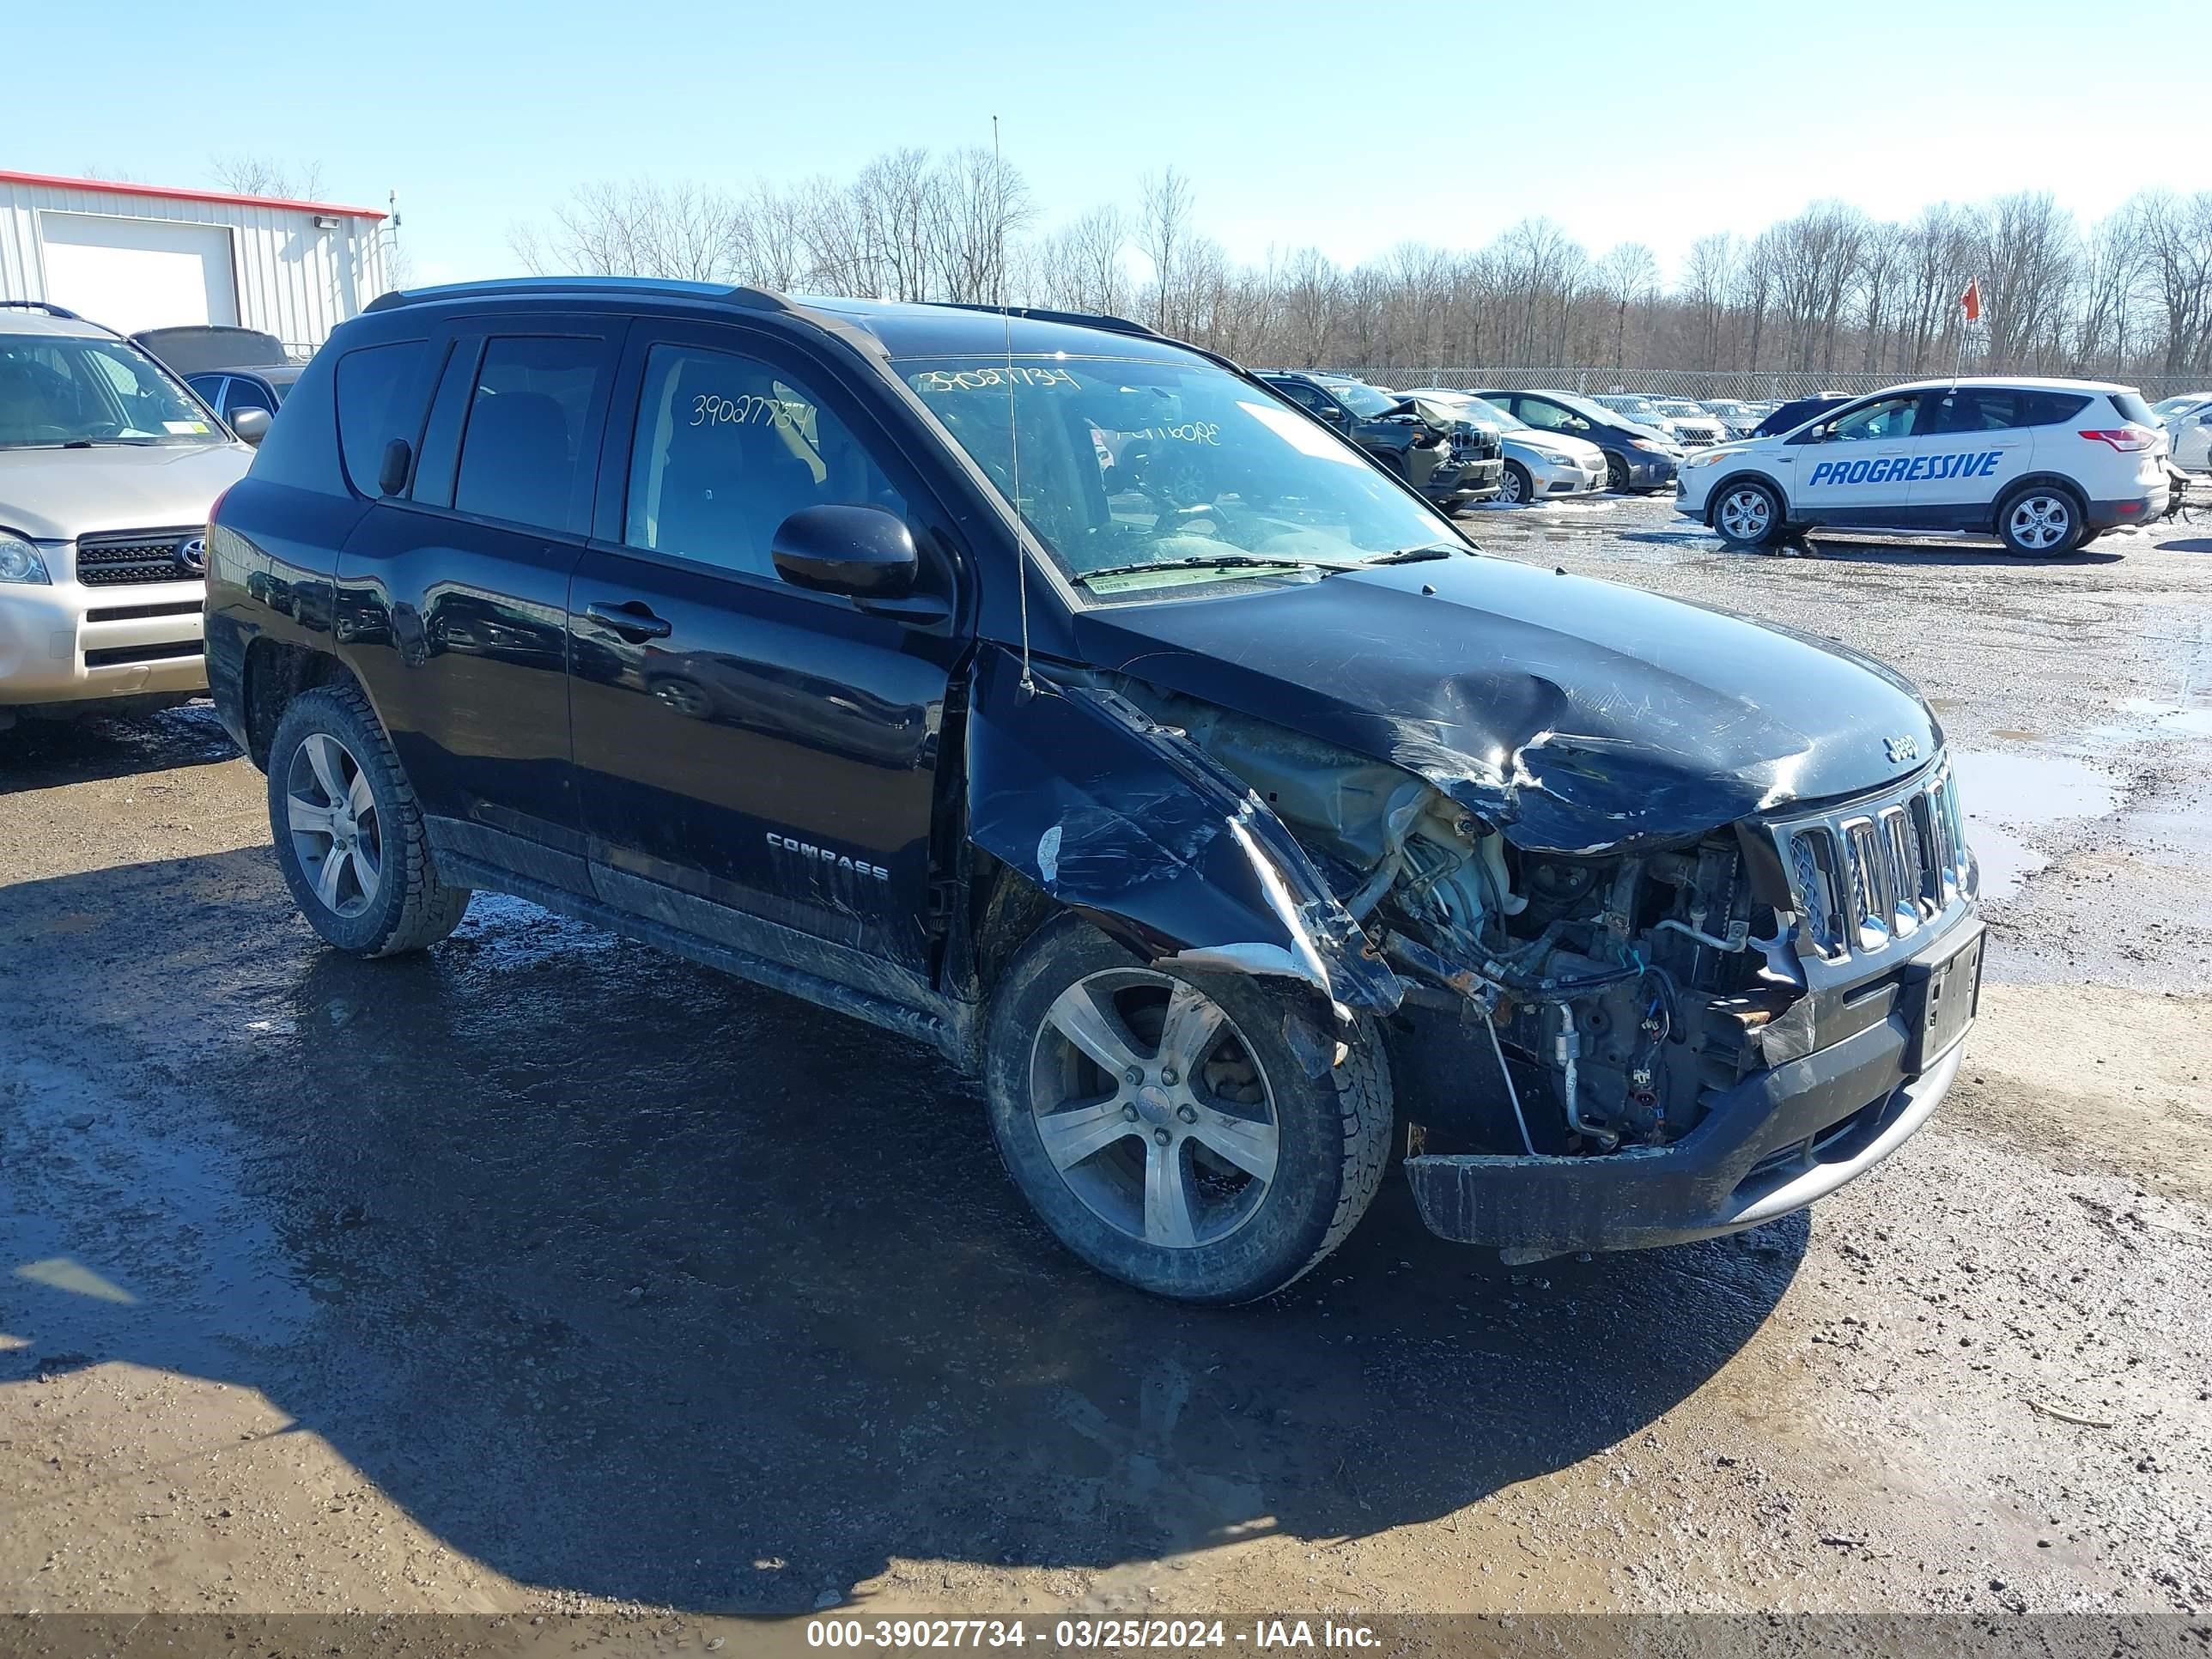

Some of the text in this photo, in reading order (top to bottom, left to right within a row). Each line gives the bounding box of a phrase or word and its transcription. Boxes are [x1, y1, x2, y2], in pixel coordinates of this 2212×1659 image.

[690, 394, 817, 436] 39027734
[1808, 451, 2003, 486] PROGRESSIVE
[1882, 734, 1919, 764] Jeep
[766, 831, 889, 881] COMPASS
